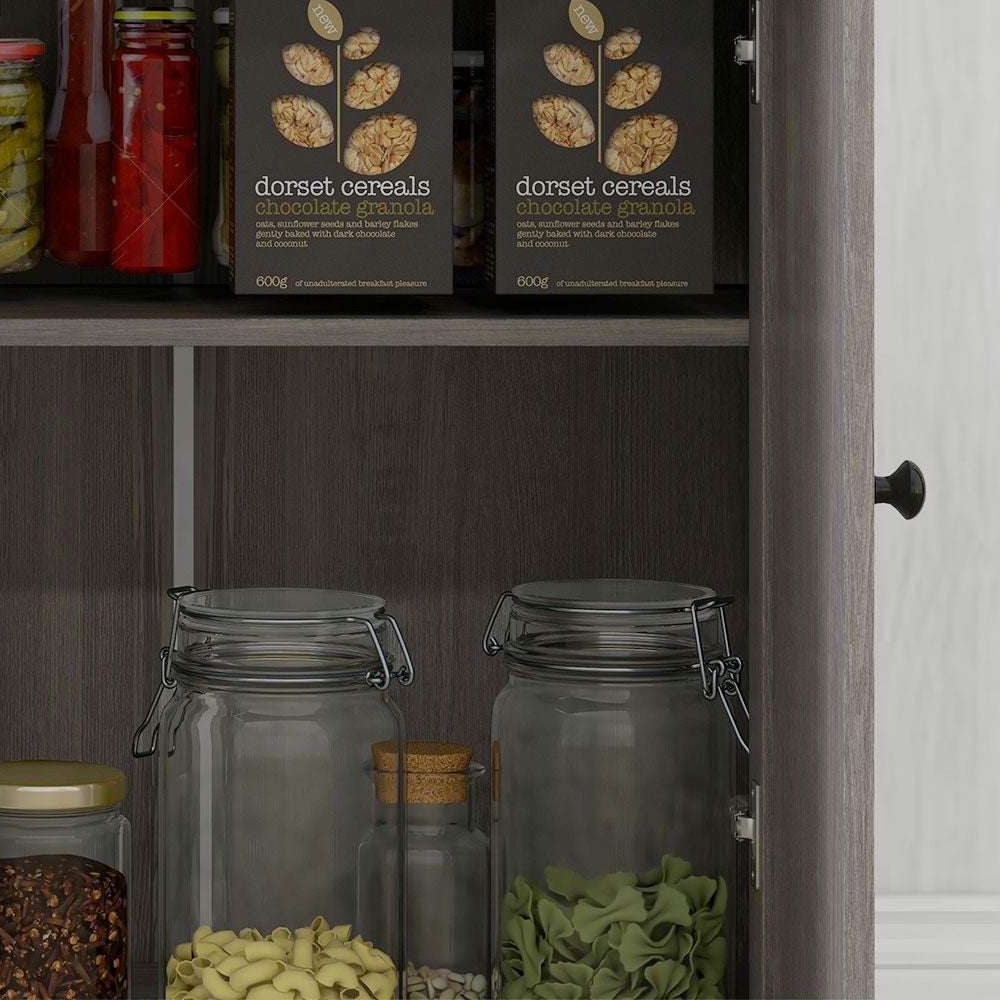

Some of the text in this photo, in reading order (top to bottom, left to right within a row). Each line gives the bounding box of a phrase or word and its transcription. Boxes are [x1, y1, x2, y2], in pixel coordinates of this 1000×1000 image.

[311, 3, 338, 35] new
[572, 3, 599, 35] new
[255, 176, 430, 196] dorset cereals
[516, 176, 691, 196] dorset cereals
[256, 199, 434, 218] chocolate granola
[517, 199, 695, 218] chocolate granola
[256, 220, 418, 230] oats, sunflower seeds and barley flakes
[517, 221, 536, 229] oats,
[626, 221, 652, 230] barley
[655, 220, 679, 228] flakes
[256, 230, 395, 239] gently baked with dark chocolate
[517, 230, 656, 239] gently baked with dark chocolate
[256, 240, 272, 248] and
[517, 240, 533, 248] and
[256, 276, 288, 289] 600g
[304, 280, 356, 288] unadulterated
[395, 280, 427, 288] pleasure
[517, 276, 549, 289] 600g
